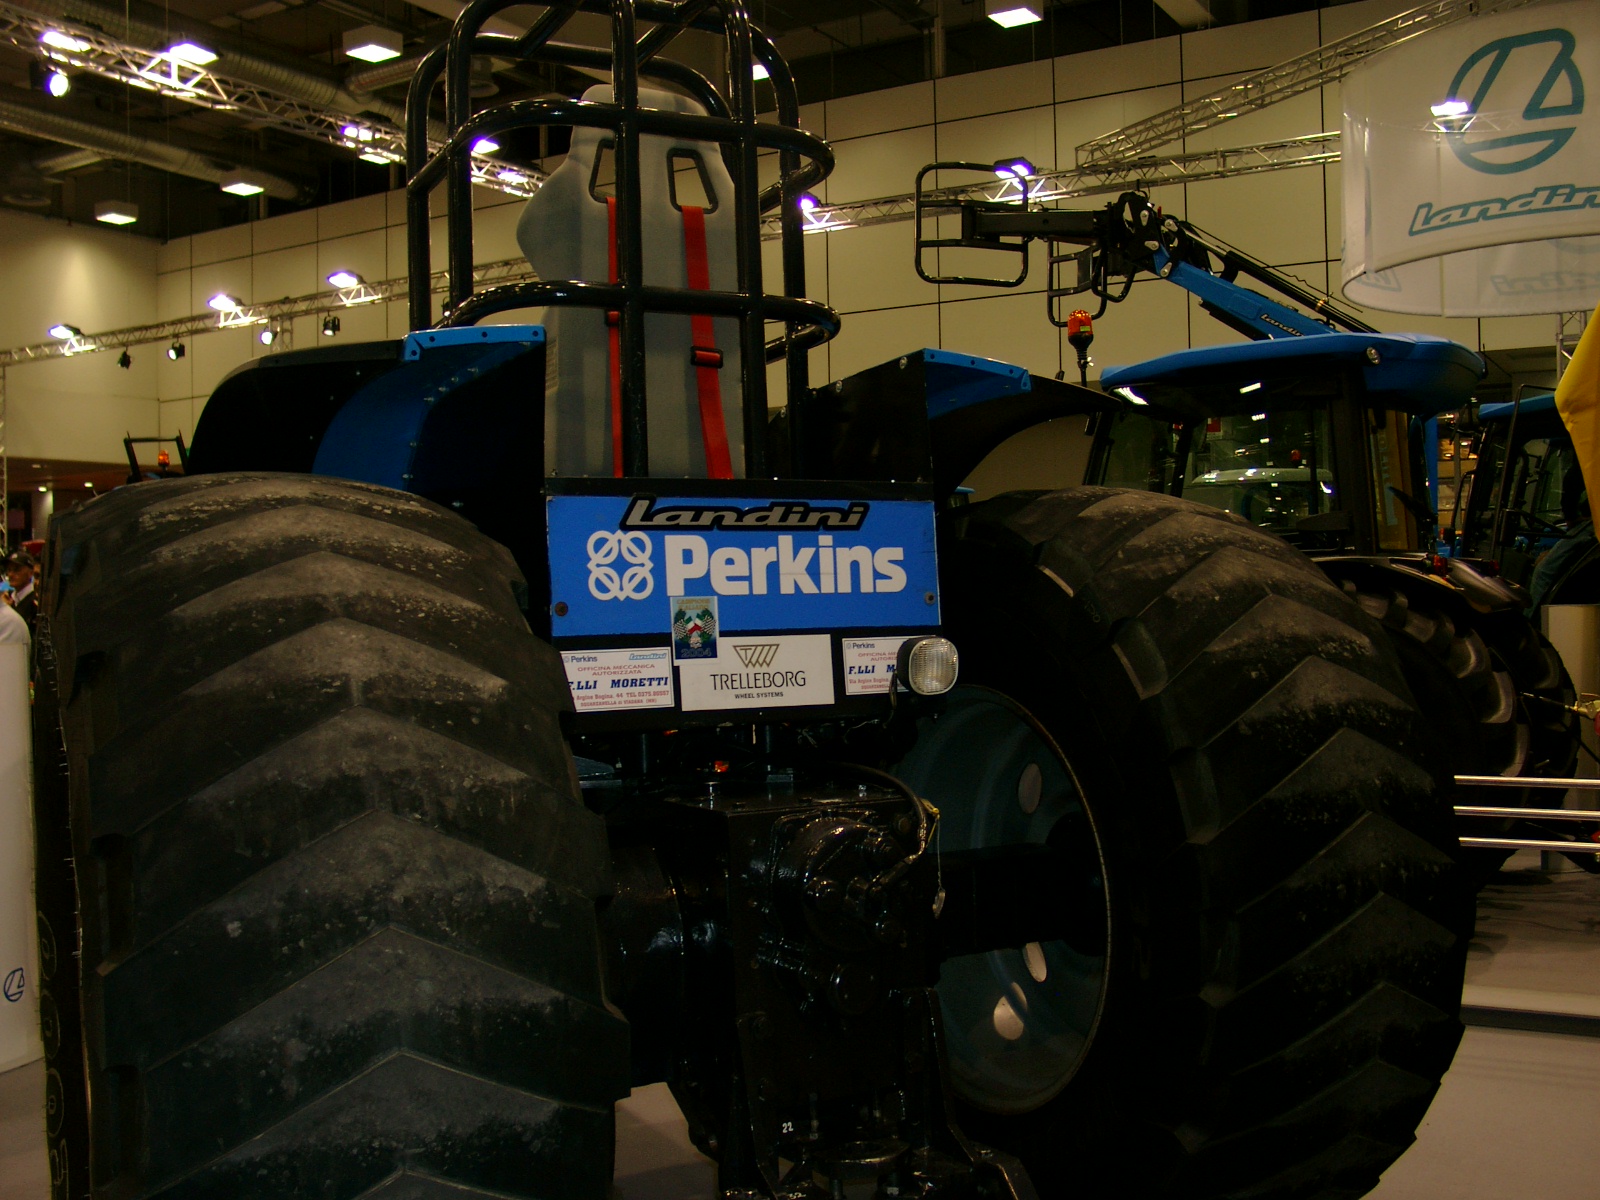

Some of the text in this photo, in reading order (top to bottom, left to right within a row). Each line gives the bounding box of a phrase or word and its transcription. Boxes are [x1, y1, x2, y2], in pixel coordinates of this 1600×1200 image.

[621, 497, 868, 530] Landini
[664, 535, 907, 596] Perkins
[571, 655, 598, 663] Perkins
[848, 665, 875, 674] F.LLI
[611, 677, 668, 688] MORETTI
[710, 671, 806, 690] TRELLEBORG
[782, 1121, 794, 1133] 22
